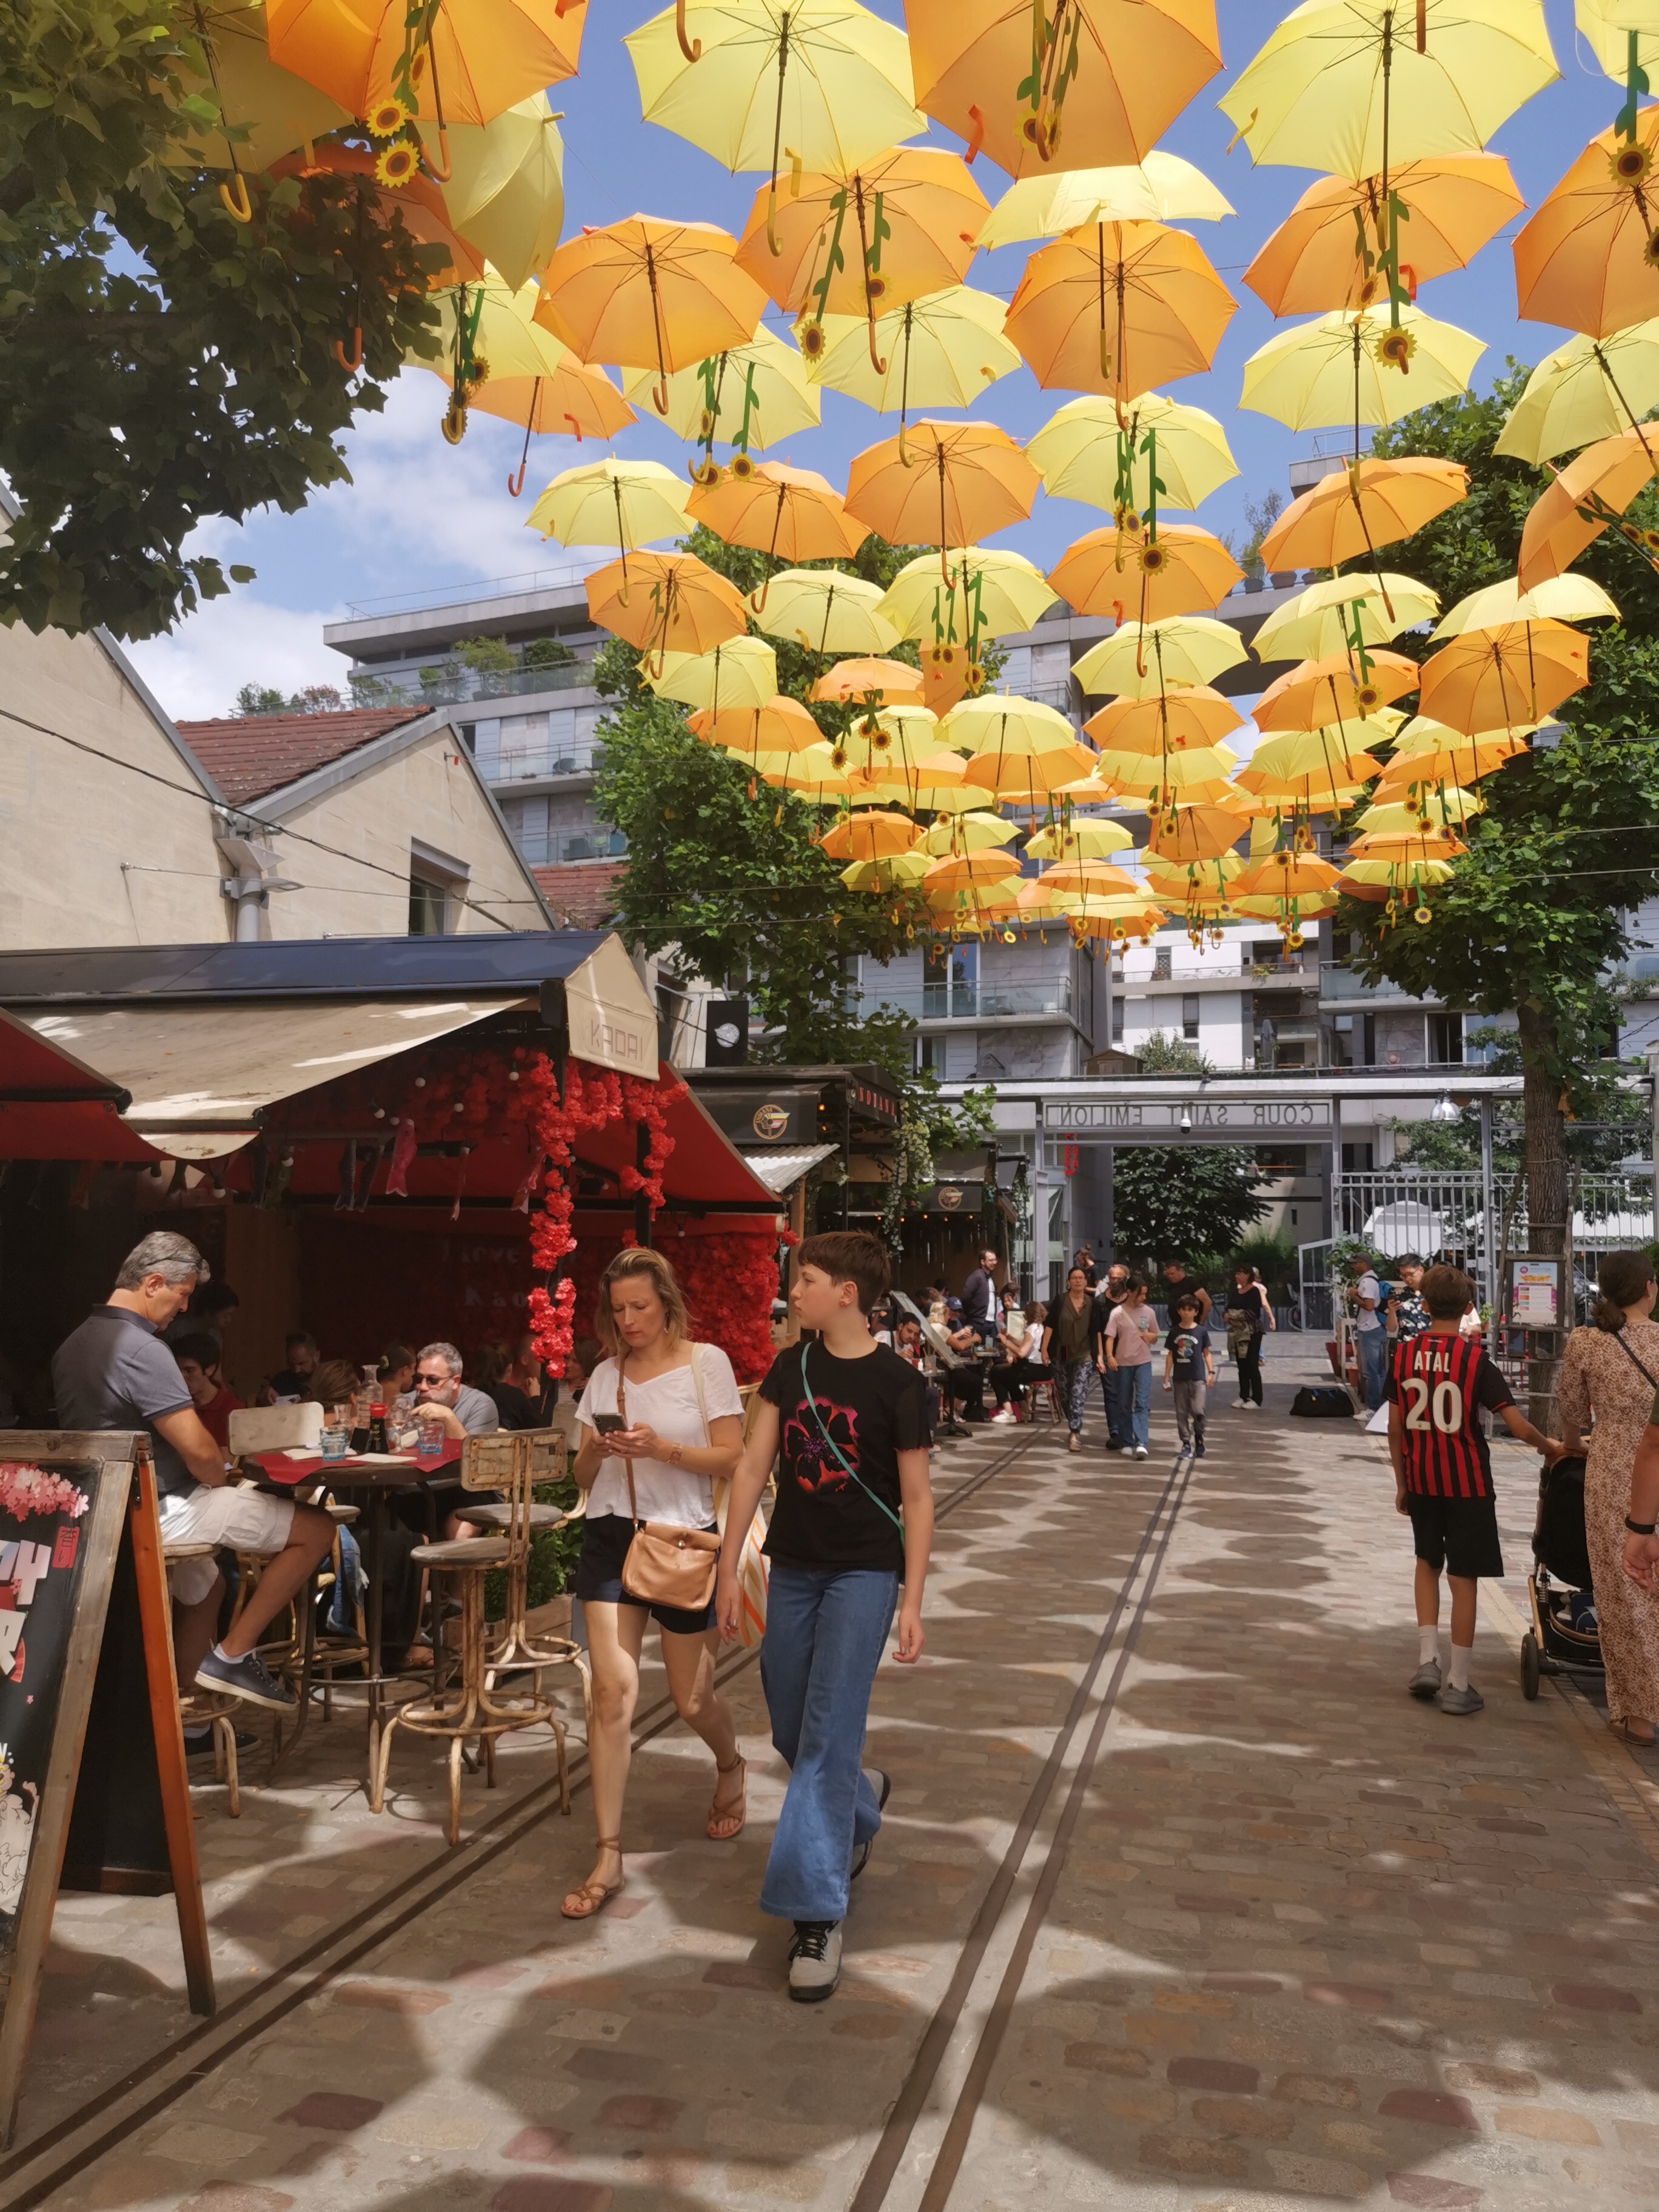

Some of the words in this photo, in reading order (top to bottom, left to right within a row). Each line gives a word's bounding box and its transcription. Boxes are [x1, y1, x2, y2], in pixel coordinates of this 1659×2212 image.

[591, 1019, 643, 1062] KAORI
[856, 1087, 895, 1116] NDIANA
[1414, 1350, 1450, 1373] ATAL
[1400, 1377, 1463, 1433] 20
